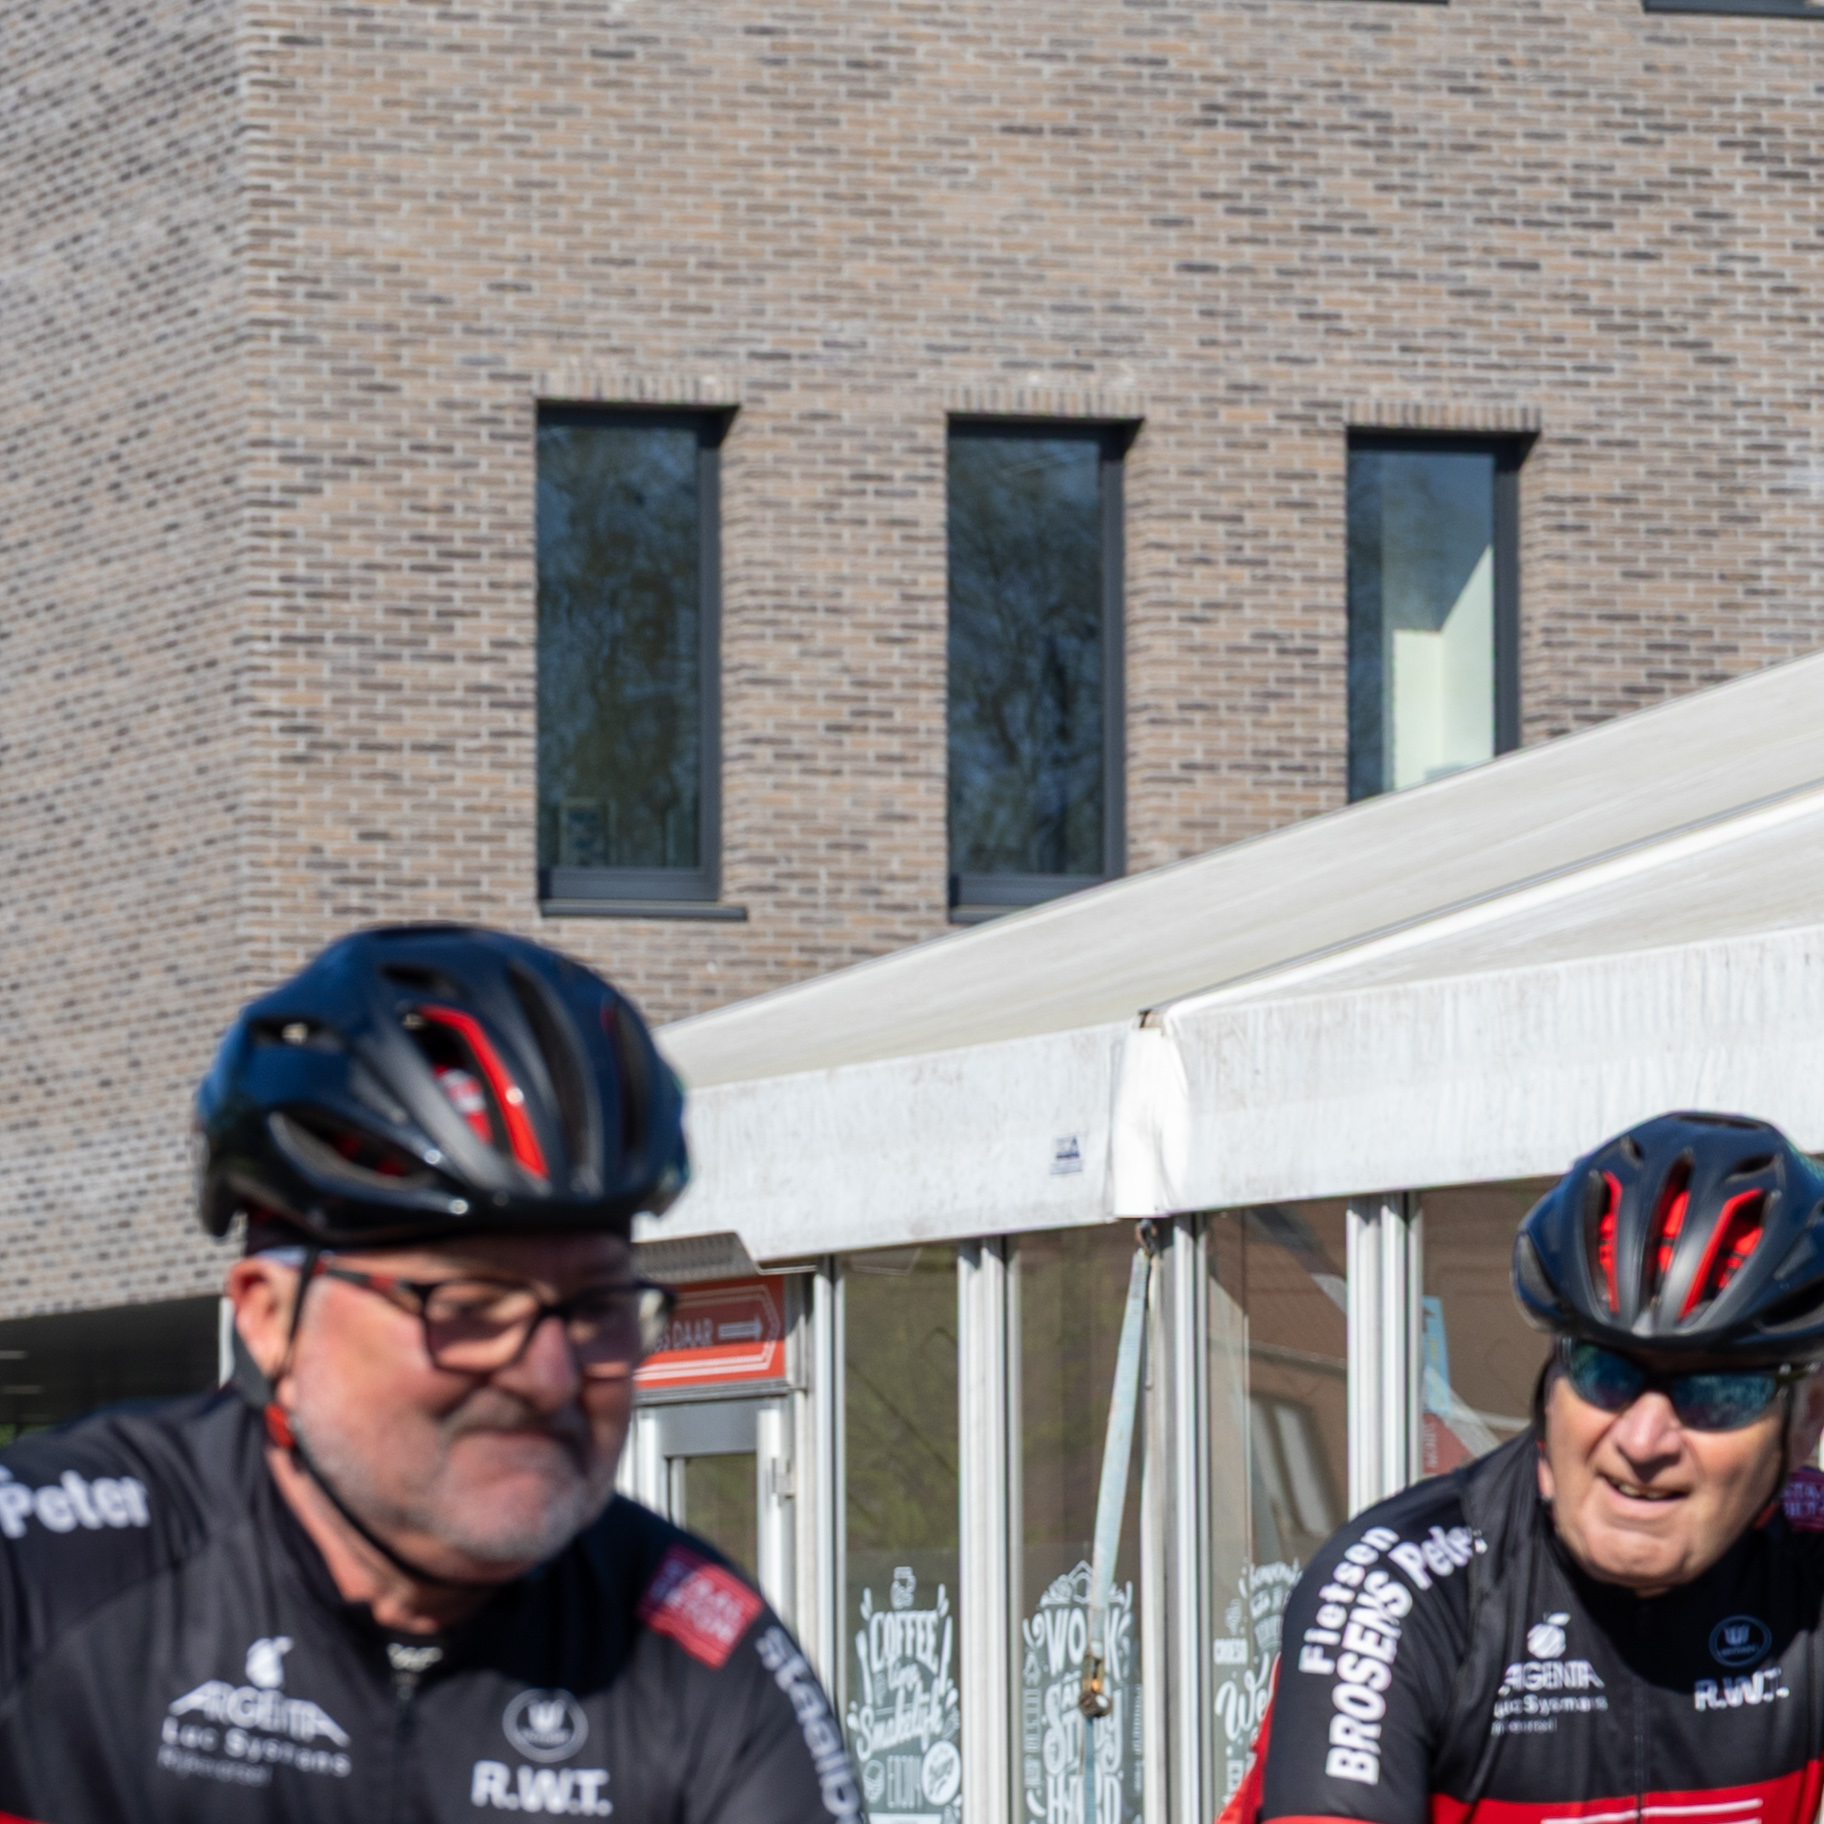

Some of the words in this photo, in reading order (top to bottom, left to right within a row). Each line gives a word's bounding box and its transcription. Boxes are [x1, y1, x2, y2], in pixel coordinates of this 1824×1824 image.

[1299, 1525, 1399, 1676] Fietsen
[870, 1610, 939, 1676] COFFEE
[1044, 1606, 1122, 1686] WOK
[1325, 1571, 1412, 1785] BROSENS
[471, 1760, 613, 1816] R.W.T.
